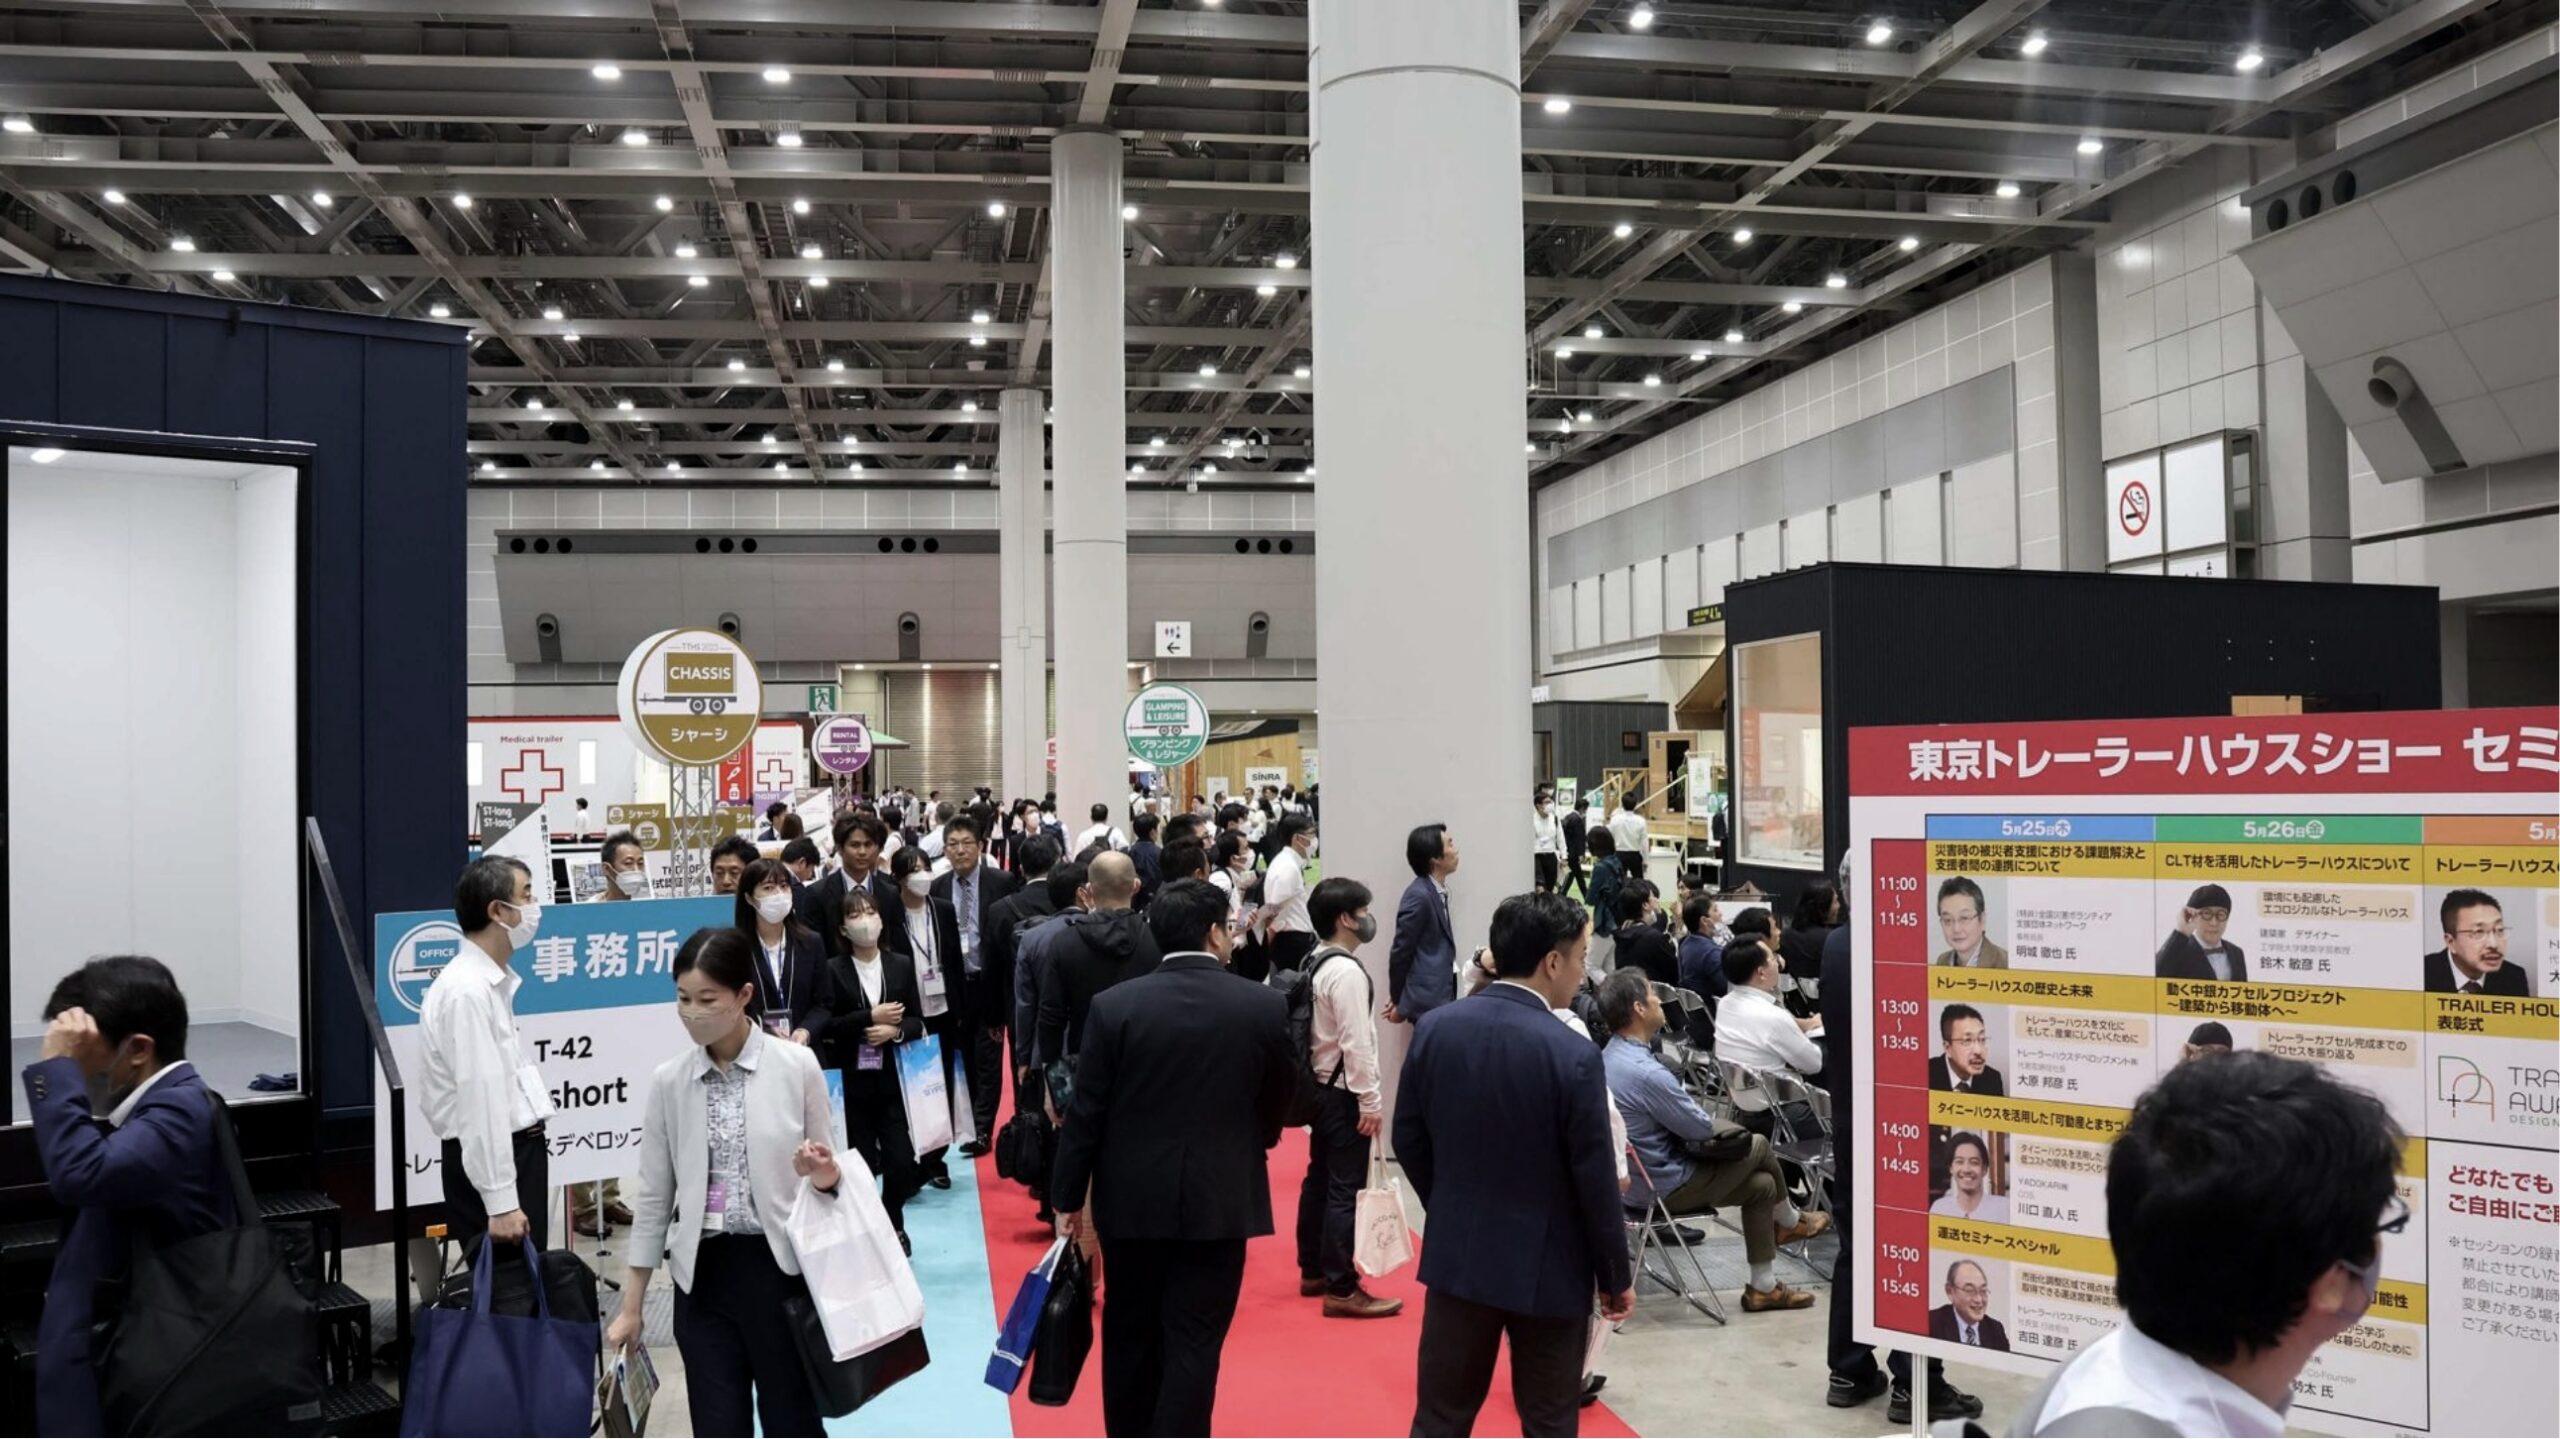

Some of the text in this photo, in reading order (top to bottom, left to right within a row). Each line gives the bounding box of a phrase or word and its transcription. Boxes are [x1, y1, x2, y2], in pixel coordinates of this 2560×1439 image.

[669, 666, 731, 680] CHASSIS
[1145, 702, 1186, 711] GLAMPING
[1154, 712, 1186, 720] LEISURE
[500, 736, 563, 744] Medical trailer
[671, 727, 728, 743] シャーシ
[1139, 738, 1191, 749] グランピング
[1155, 750, 1188, 760] レジャー
[1909, 731, 2442, 782] 東京トレーラーハウスショー
[482, 806, 513, 818] ST-long
[628, 809, 660, 819] シャーシ
[1935, 843, 2146, 861] 災害時の被災者支援における課題解決と
[1934, 858, 2061, 874] 支援者間の連携について
[2165, 852, 2410, 872] CLT材を活用したトレーラーハウスについて
[2435, 857, 2559, 875] トレーラーハウス
[1879, 876, 1917, 891] 11:00
[2263, 891, 2341, 904] 環境にも配慮した
[1879, 911, 1918, 927] 11:45
[2263, 904, 2409, 919] エコロジカルなトレーラーハウス
[2295, 929, 2340, 940] デザイナー
[419, 947, 456, 959] OFFICE
[531, 928, 679, 983] 事務所
[2065, 947, 2077, 960] 氏
[2260, 956, 2285, 970] 鈴木
[2318, 958, 2331, 972] 氏
[1936, 976, 2094, 999] トレーラーハウスの歴史と未来
[2166, 981, 2346, 1006] 動く中銀カプセルプロジェクト
[1880, 999, 1918, 1015] 13:00
[2437, 997, 2516, 1016] TRAILER
[2025, 1015, 2125, 1032] トレーラーハウスを文化に
[2437, 1013, 2485, 1032] 表彰式
[533, 1035, 593, 1063] T-42
[1881, 1034, 1919, 1051] 13:45
[2266, 1031, 2407, 1051] トレーラーカプセル完成までの
[2017, 1074, 2039, 1088] 大原
[2067, 1077, 2079, 1092] 氏
[2509, 1091, 2559, 1115] AW
[1937, 1101, 2129, 1133] タイニーハウスを活用した「可動産とまちづ
[1881, 1121, 1920, 1139] 14:00
[1881, 1156, 1920, 1175] 14:45
[2448, 1165, 2553, 1195] どなたでも
[2018, 1201, 2080, 1223] 川口 直人 氏
[1936, 1225, 2061, 1257] 運送セミナースペシャル
[1881, 1243, 1920, 1262] 15:00
[1881, 1278, 1920, 1298] 15:45
[2018, 1330, 2040, 1345] 吉田
[2067, 1338, 2080, 1353] 氏
[2321, 1384, 2334, 1399] 氏
